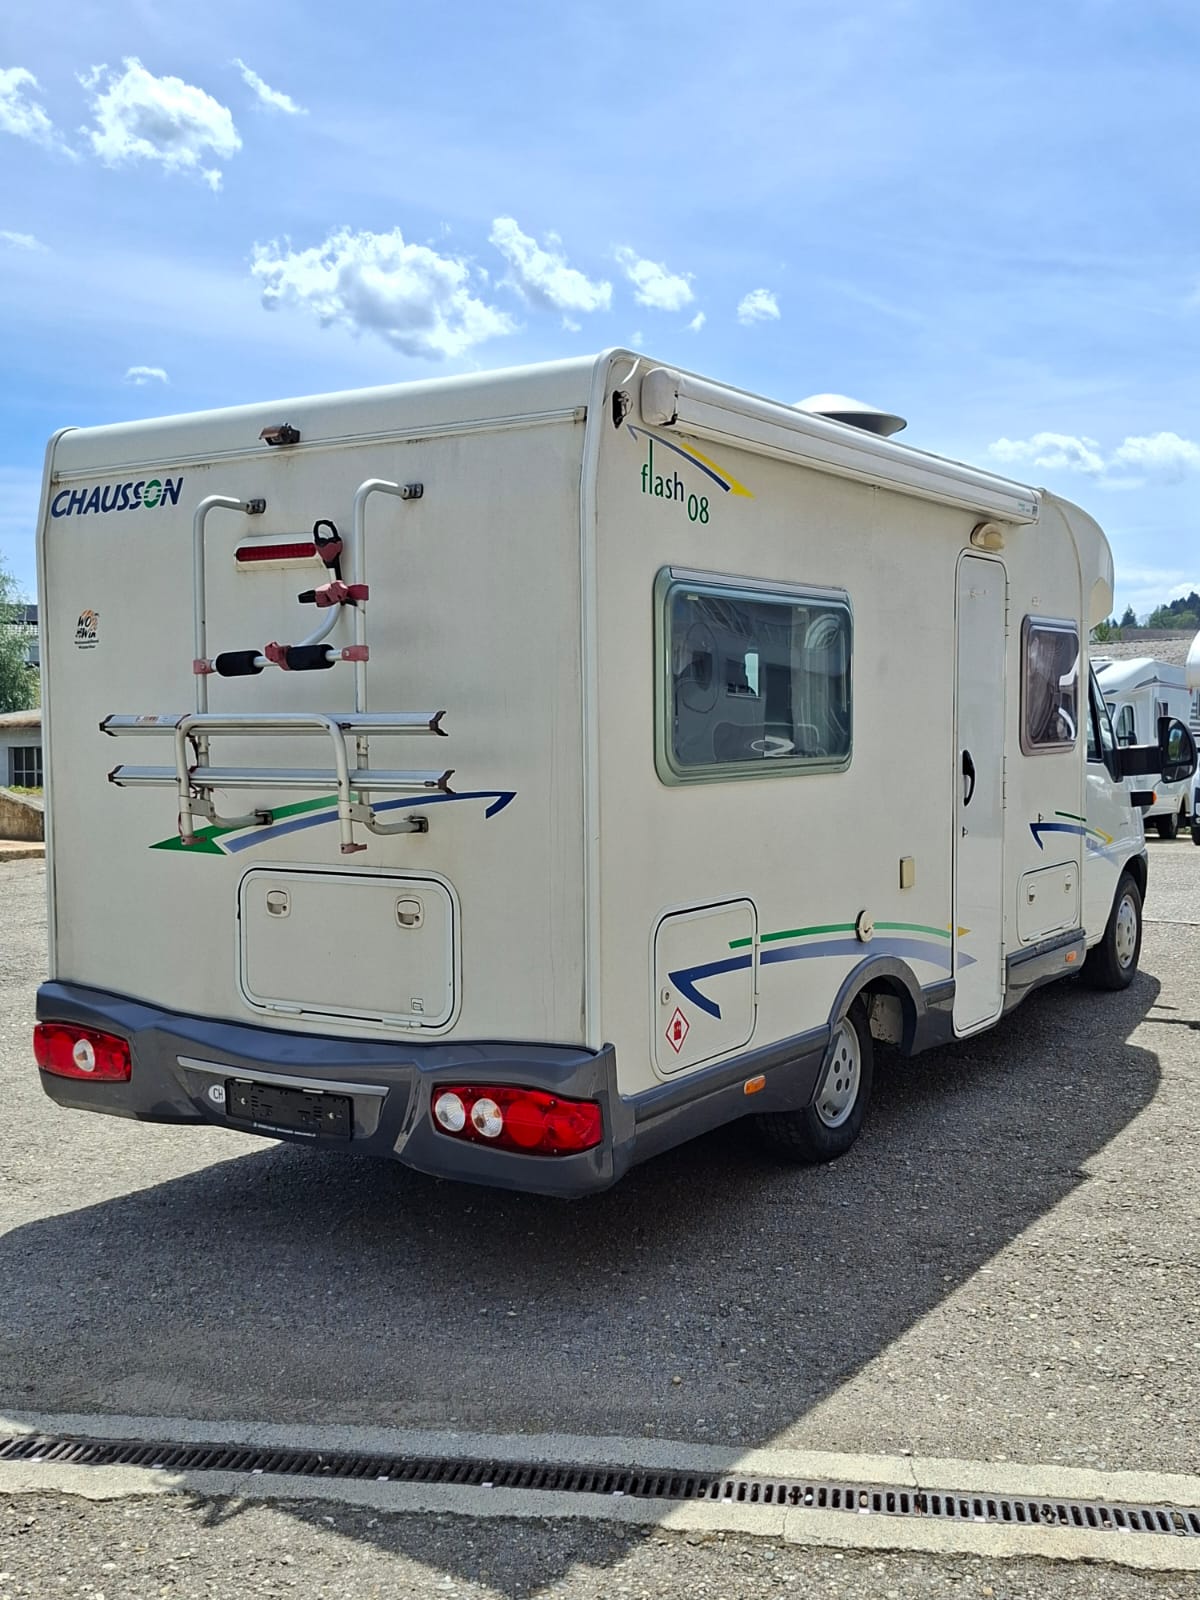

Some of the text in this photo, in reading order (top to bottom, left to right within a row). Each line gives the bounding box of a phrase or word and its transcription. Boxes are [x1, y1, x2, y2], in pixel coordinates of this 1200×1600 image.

[51, 477, 184, 518] CHAUSSON
[640, 438, 709, 524] flash 08
[213, 1087, 224, 1100] CH
